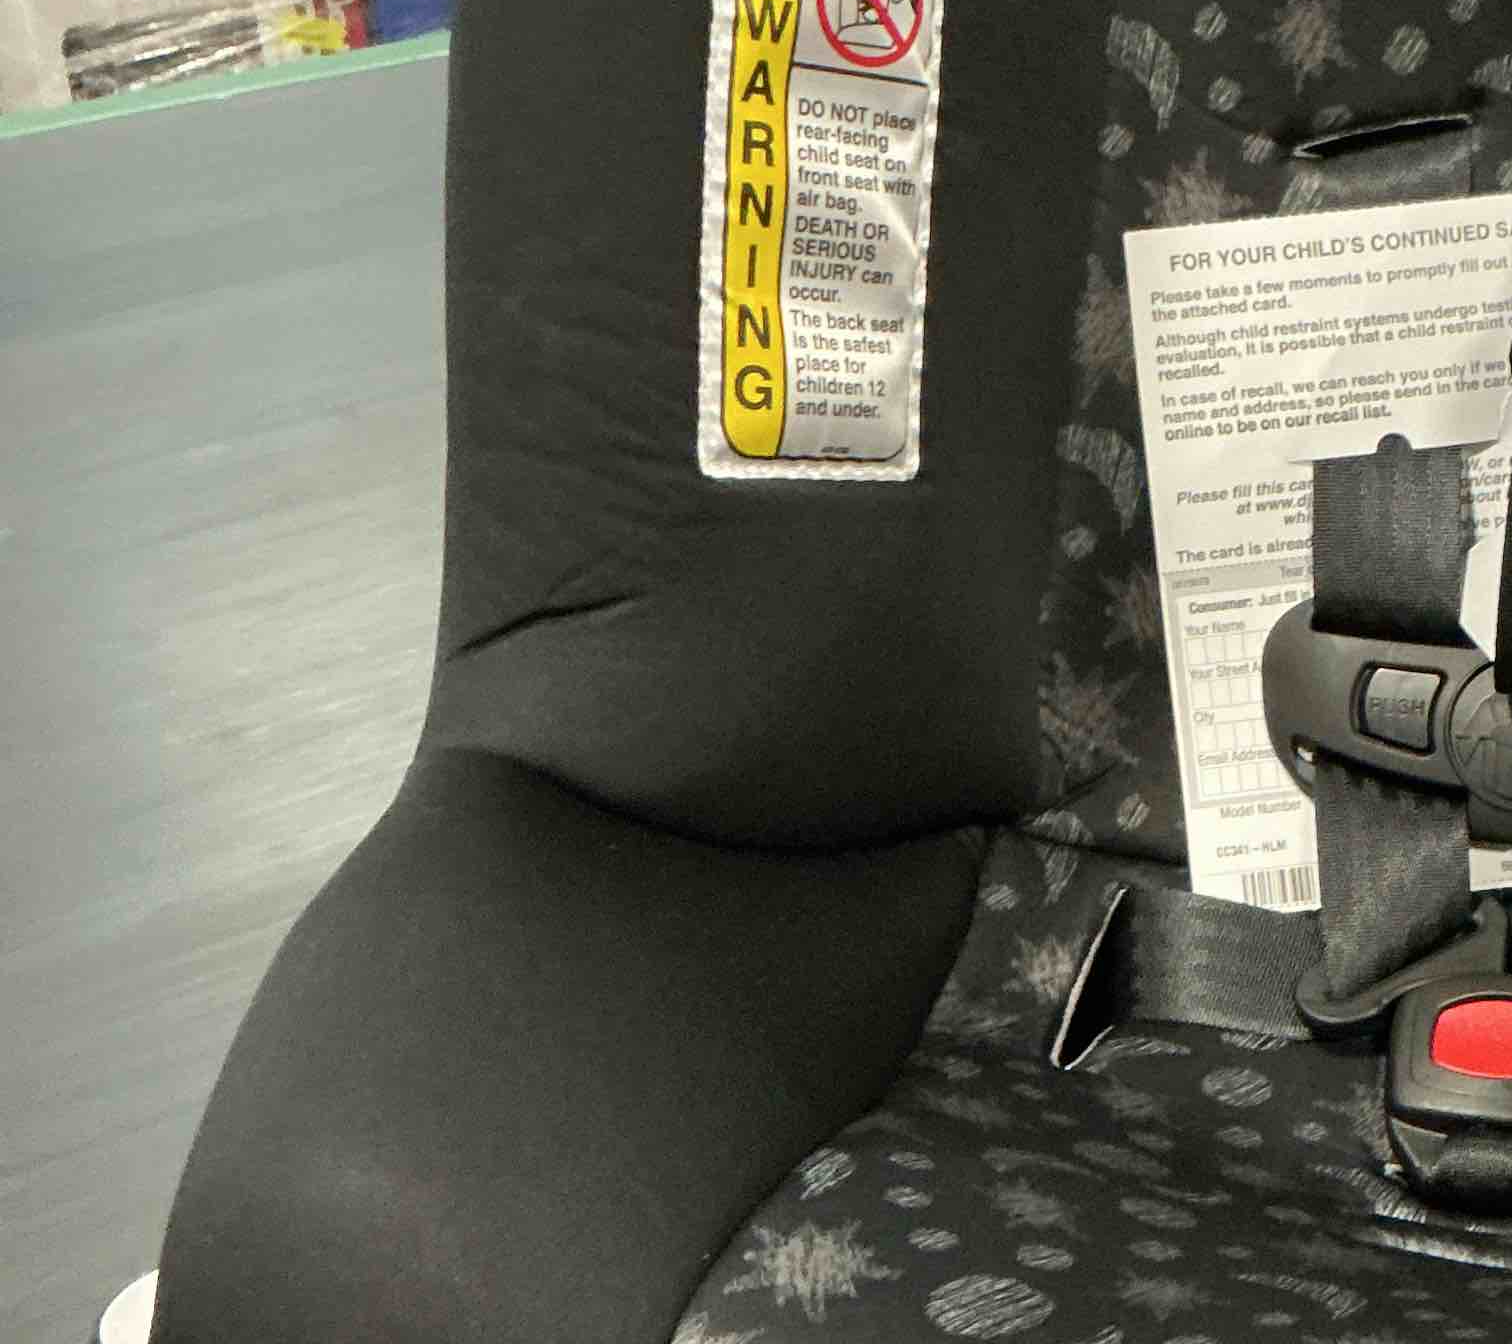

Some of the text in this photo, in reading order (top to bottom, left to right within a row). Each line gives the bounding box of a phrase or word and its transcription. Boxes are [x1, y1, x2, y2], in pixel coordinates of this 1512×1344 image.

[797, 97, 916, 132] DO NOT place
[795, 120, 889, 152] rear-facing
[797, 144, 906, 172] child seat on
[796, 166, 916, 195] front seat with
[796, 188, 864, 216] air bag.
[794, 214, 890, 241] DEATH OR
[791, 234, 876, 264] SERIOUS
[1168, 251, 1211, 272] FOR
[1216, 243, 1277, 268] YOUR
[1281, 235, 1365, 261] CHILD'S
[1370, 222, 1490, 252] CONTINUED
[789, 257, 893, 285] INJURY can
[1149, 286, 1202, 307] Please
[1205, 282, 1239, 300] take
[1256, 277, 1283, 294] few
[1288, 270, 1362, 291] moments
[1366, 269, 1383, 282] to
[1386, 261, 1456, 284] promptly
[1459, 257, 1479, 273] fill
[1482, 255, 1508, 270] out
[788, 283, 841, 304] occur.
[788, 308, 905, 333] The back seat
[1151, 294, 1292, 323] the attached card.
[1154, 327, 1226, 351] Although
[1228, 322, 1269, 341] child
[1272, 316, 1339, 337] restraint
[1343, 310, 1410, 333] systems
[1412, 301, 1478, 324] undergo
[792, 331, 892, 356] is the safest
[1155, 342, 1242, 367] evaluation,
[1259, 338, 1274, 353] is
[1278, 332, 1346, 354] possible
[1349, 328, 1380, 344] that
[1397, 322, 1436, 340] child
[1439, 315, 1504, 335] restraint
[794, 353, 867, 376] place for
[1157, 361, 1224, 382] recalled.
[796, 374, 887, 399] children 12
[1160, 393, 1176, 408] In
[1179, 390, 1217, 406] case
[1220, 386, 1236, 401] of
[1292, 379, 1313, 394] we
[1318, 376, 1347, 391] can
[1351, 370, 1395, 387] reach
[1399, 368, 1428, 385] you
[1432, 362, 1466, 381] only
[1485, 359, 1505, 372] we
[795, 397, 881, 421] and under.
[1162, 408, 1206, 425] name
[1209, 403, 1239, 419] and
[1242, 395, 1312, 417] address,
[1314, 393, 1334, 407] so
[1337, 386, 1390, 407] please
[1393, 382, 1432, 399] send
[1436, 379, 1451, 393] in
[1454, 376, 1480, 391] the
[1164, 402, 1391, 441] online to be on our recall list.
[1175, 477, 1313, 505] Please fill this car
[1235, 501, 1251, 515] at
[1175, 547, 1205, 564] The
[1208, 544, 1245, 560] card
[1247, 542, 1262, 555] is
